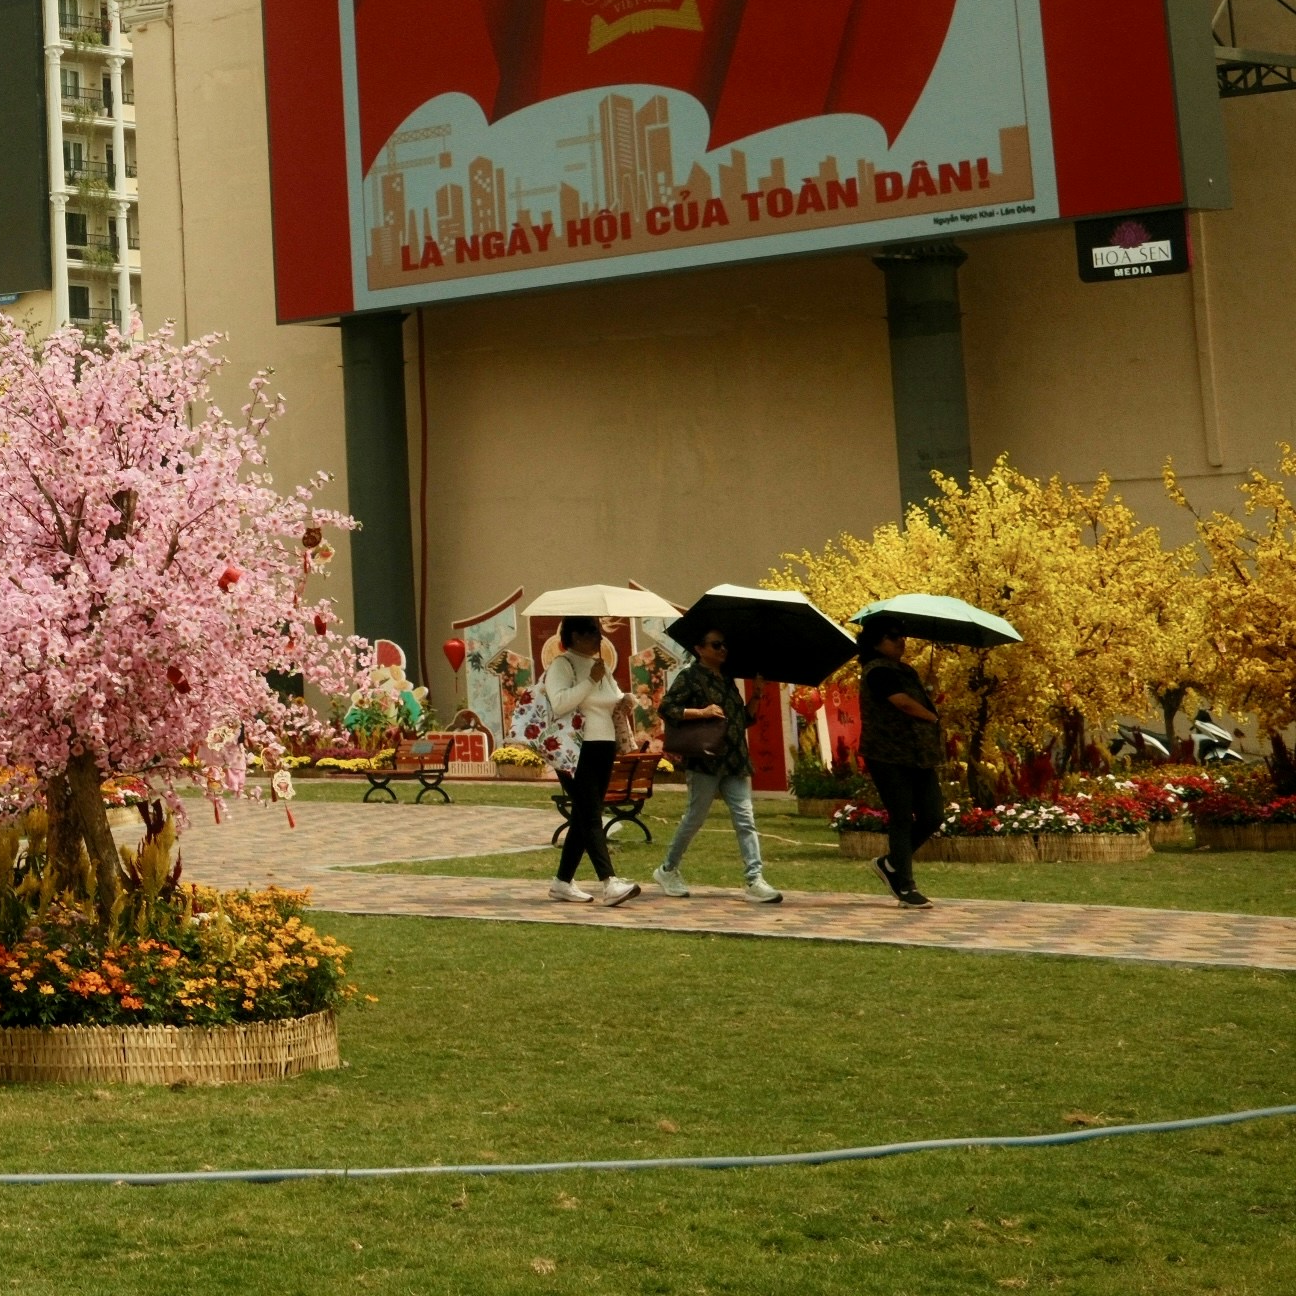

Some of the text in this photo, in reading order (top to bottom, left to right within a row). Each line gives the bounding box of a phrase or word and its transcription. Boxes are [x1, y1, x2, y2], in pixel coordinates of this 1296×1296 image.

[401, 157, 991, 271] LÀ NGÀY HỘI CỦA TOÀN DÂN!
[1094, 246, 1169, 266] HOA SEN
[1113, 265, 1153, 277] MEDIA
